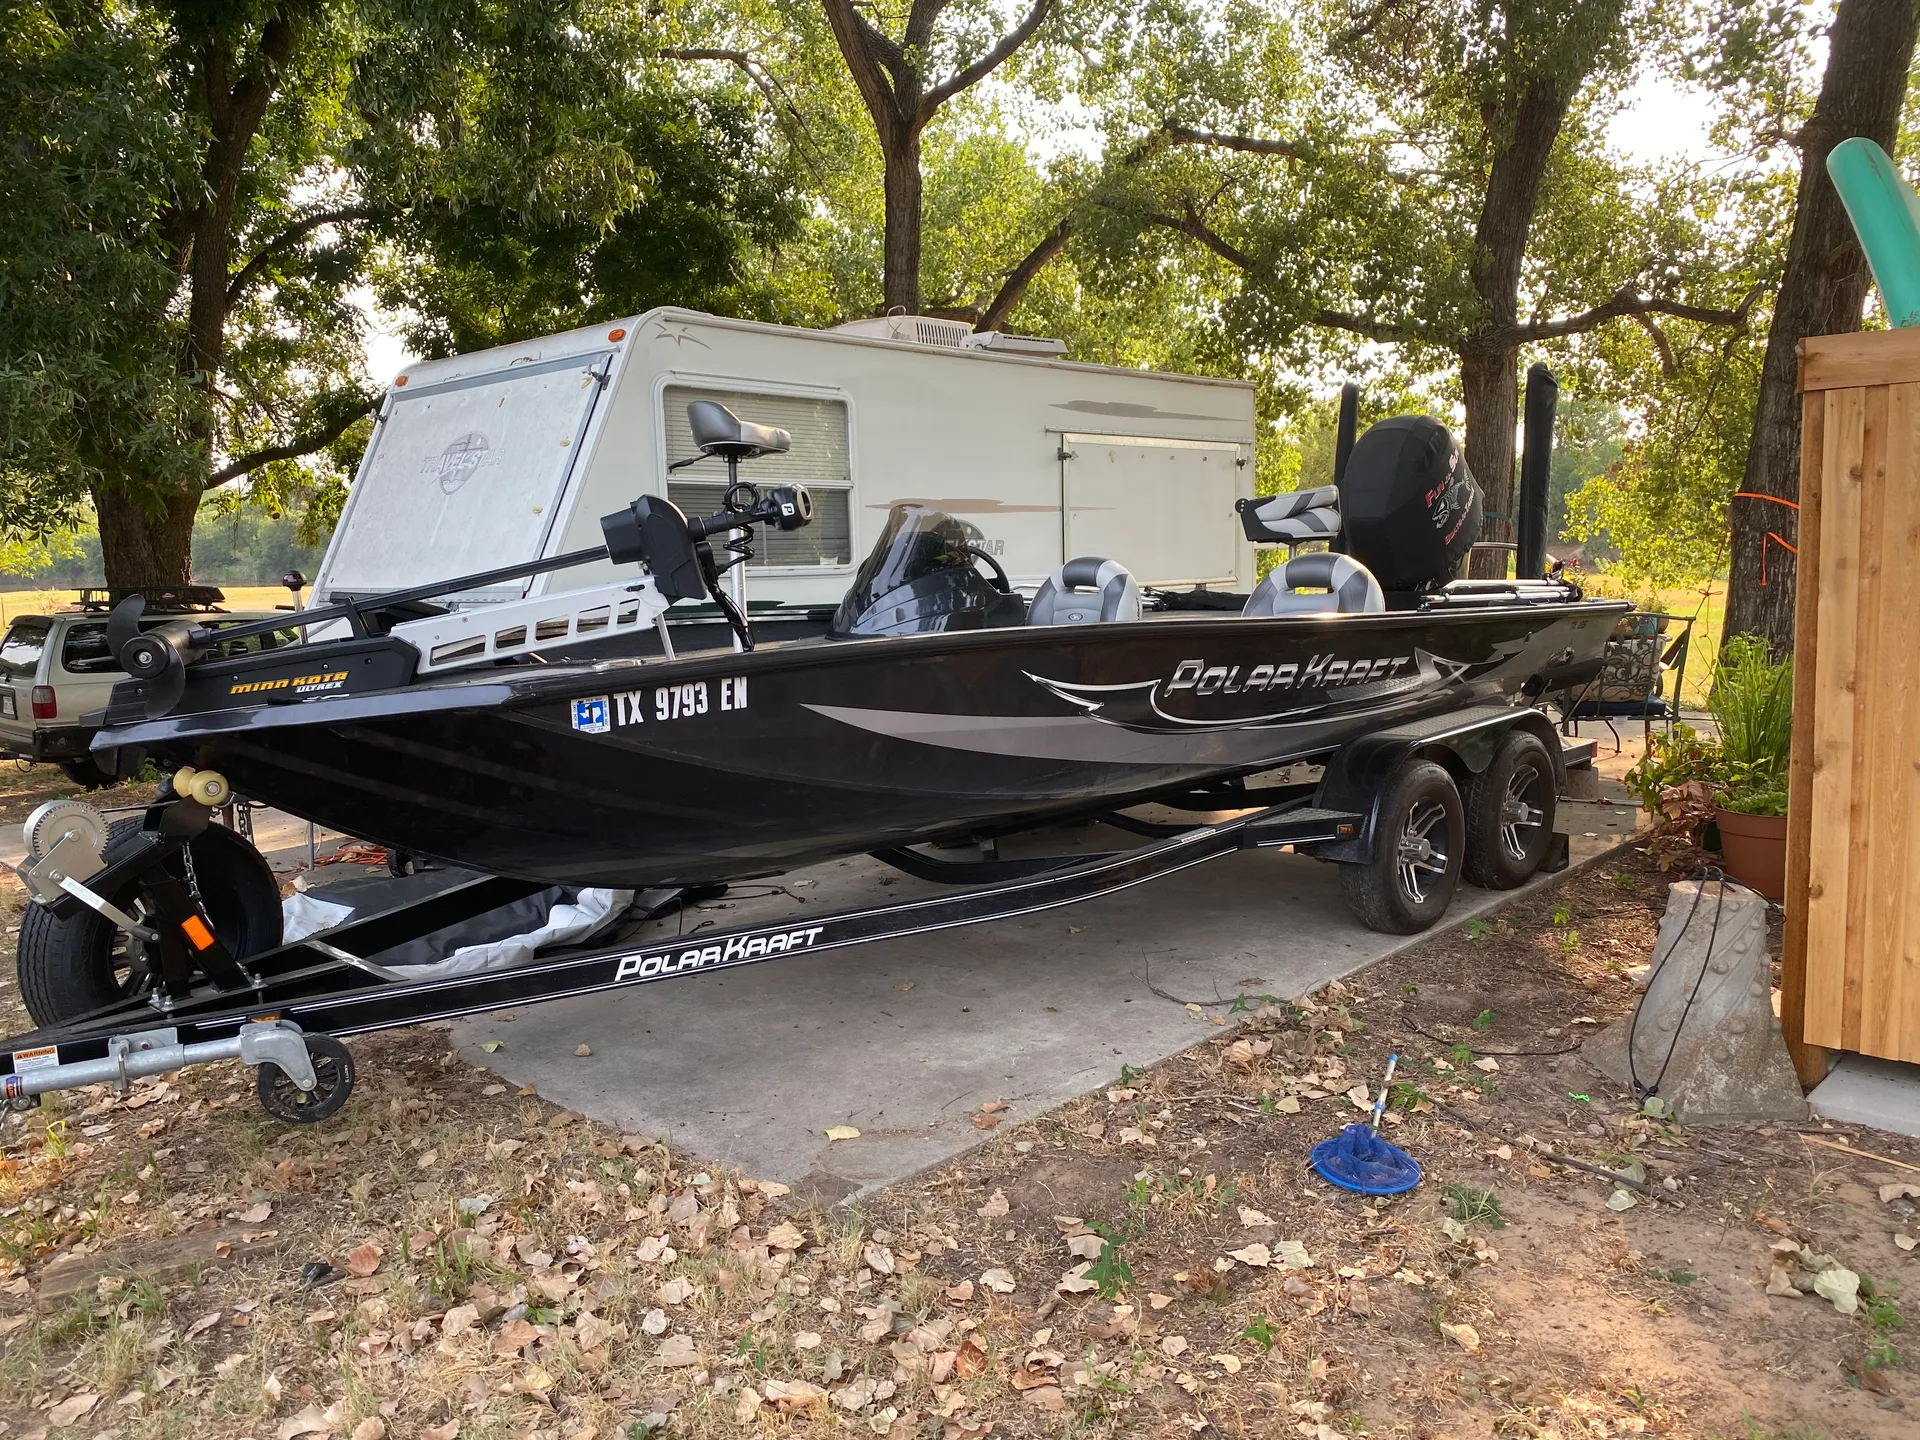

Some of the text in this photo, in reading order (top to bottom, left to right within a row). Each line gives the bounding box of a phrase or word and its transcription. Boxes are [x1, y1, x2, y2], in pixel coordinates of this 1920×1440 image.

[292, 671, 350, 687] KOTA
[295, 680, 345, 693] ULTREX
[613, 690, 645, 726] TX
[655, 681, 709, 722] 9793
[721, 676, 748, 711] EN
[22, 1047, 55, 1058] WARNING
